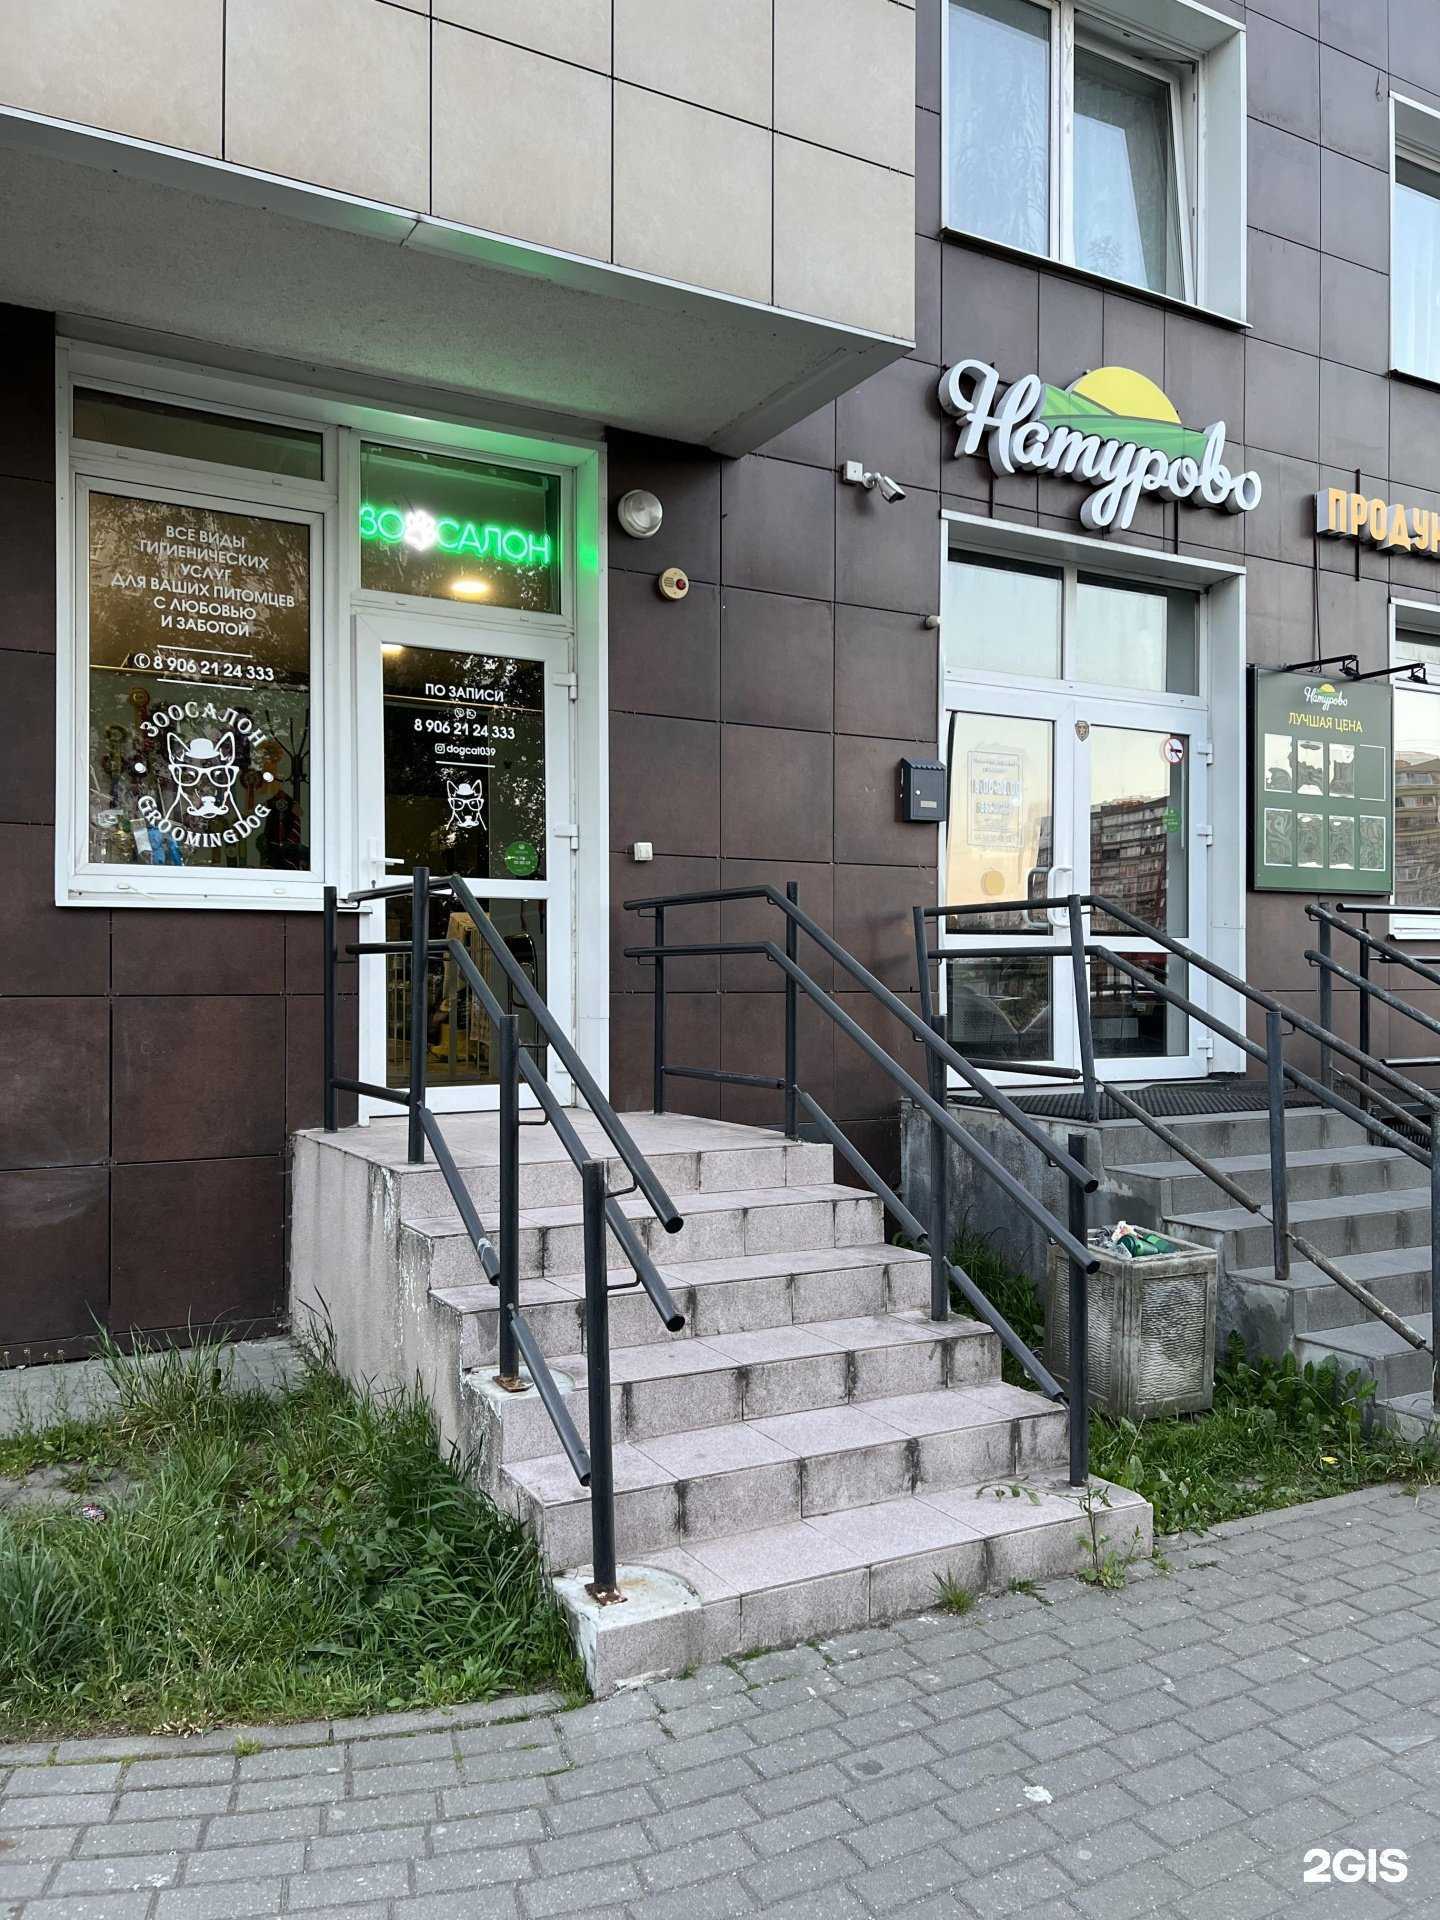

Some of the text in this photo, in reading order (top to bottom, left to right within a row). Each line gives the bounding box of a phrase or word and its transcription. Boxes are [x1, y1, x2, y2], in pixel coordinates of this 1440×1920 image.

[939, 358, 1263, 531] Натурово
[166, 525, 245, 549] ВСЕ ВИДЫ
[140, 539, 270, 571] ГИГИЕНИЧЕСКИХ
[180, 563, 232, 581] УСЛУГ
[111, 572, 296, 609] ДЛЯ ВАШИХ ПИТОМЦЕВ
[153, 596, 257, 620] С ЛЮБОВЬЮ
[161, 615, 250, 637] И ЗАБОТОЙ
[153, 656, 275, 682] 8 906 21 24 333
[425, 683, 504, 703] ПО ЗАПИСИ
[1303, 685, 1349, 712] Натурово
[140, 701, 268, 747] ЗООСАЛОН
[414, 718, 516, 740] 8 906 21 24 333
[1288, 712, 1364, 734] ЛУЧШАЯ ЦЕНА
